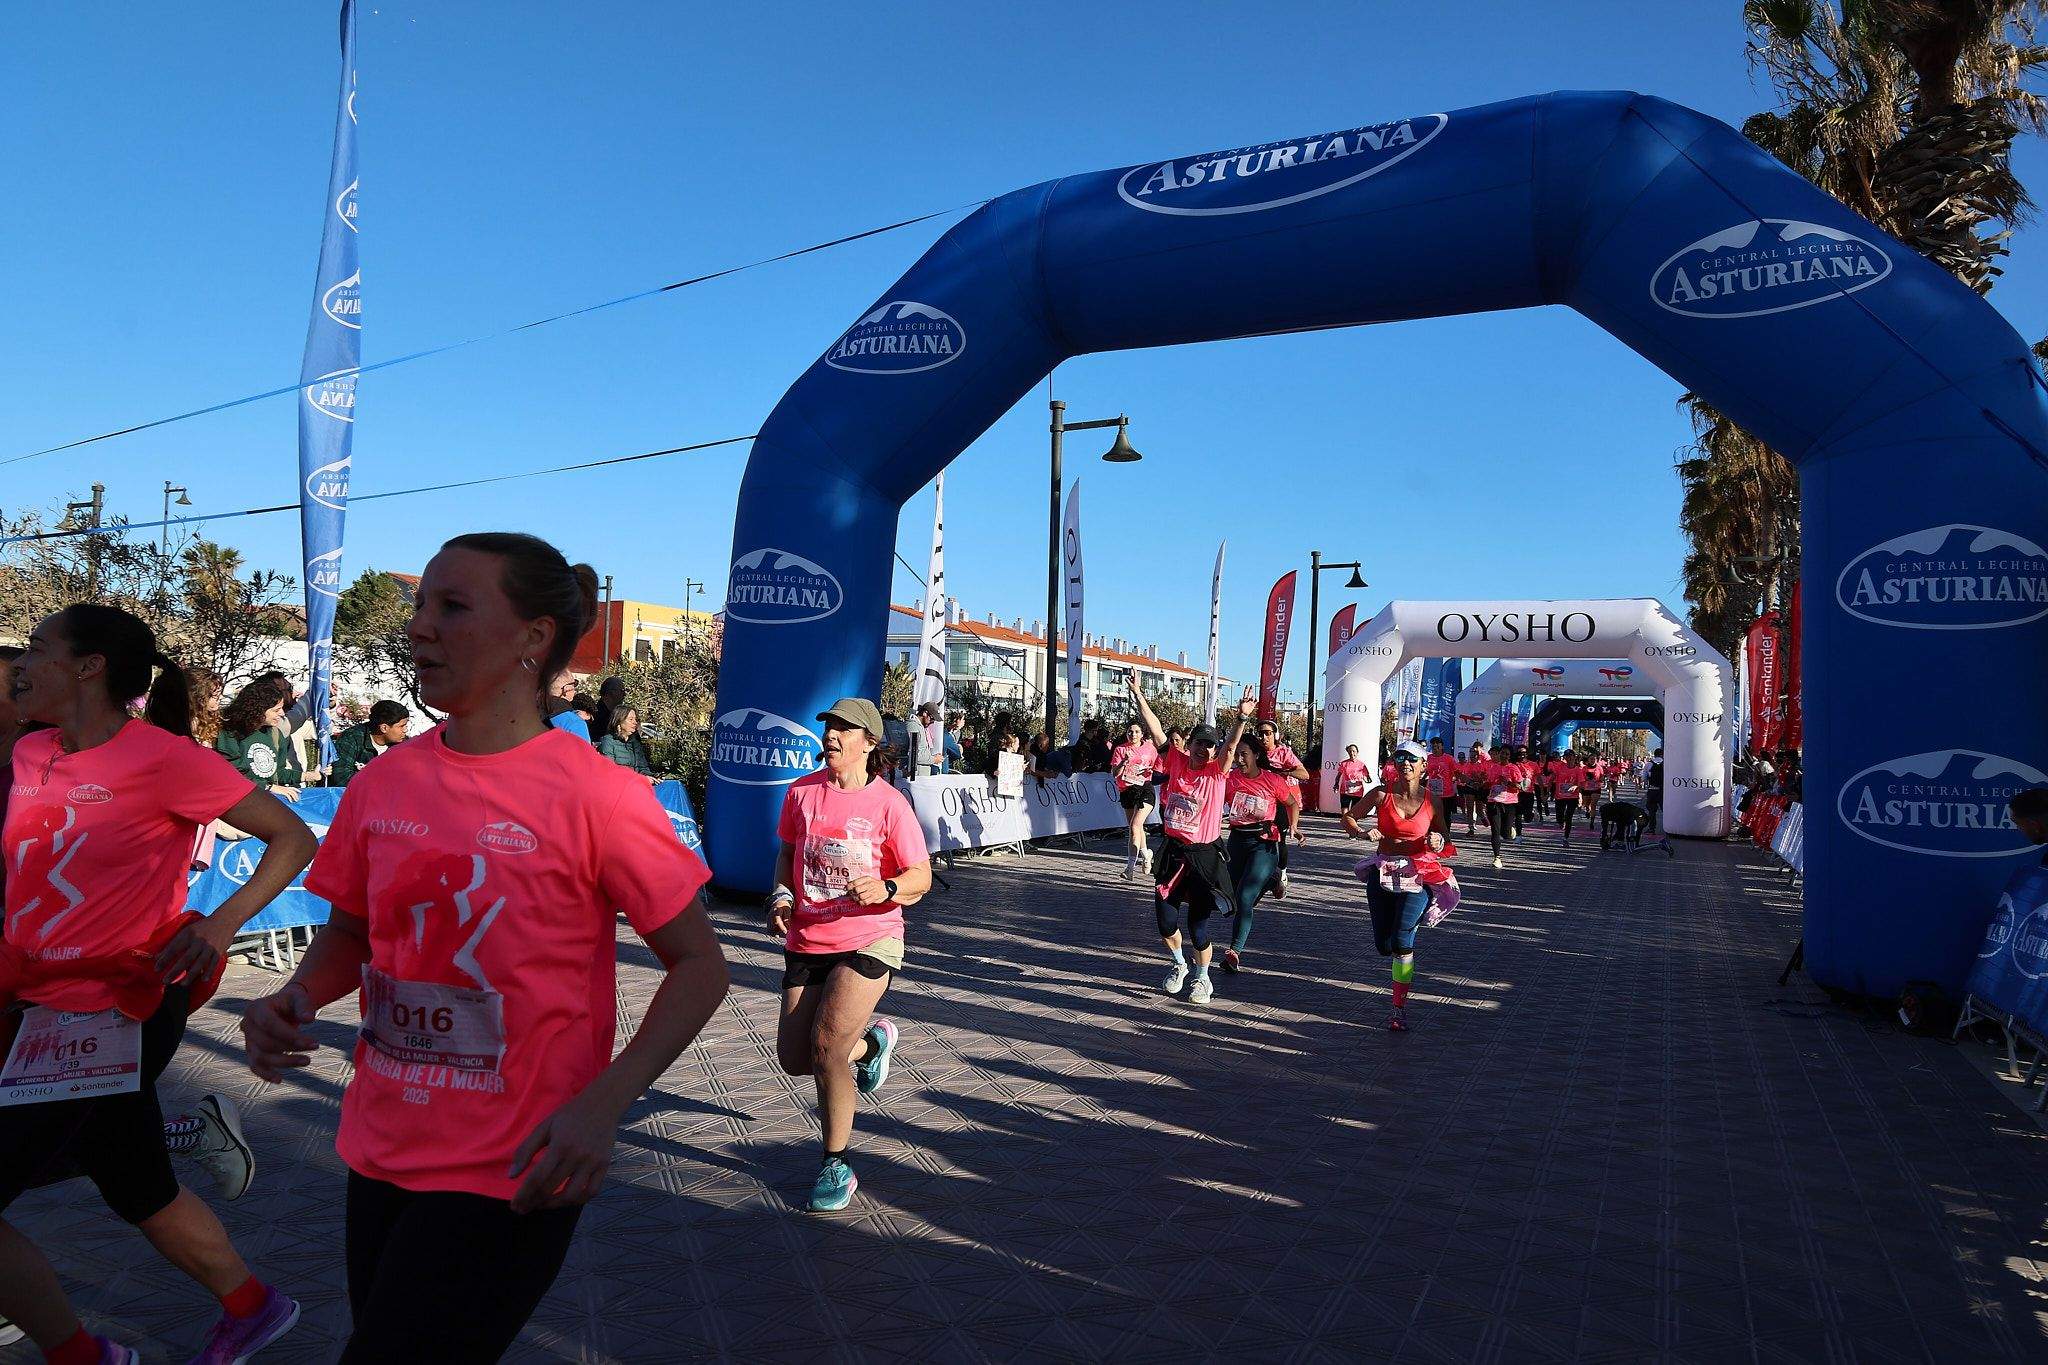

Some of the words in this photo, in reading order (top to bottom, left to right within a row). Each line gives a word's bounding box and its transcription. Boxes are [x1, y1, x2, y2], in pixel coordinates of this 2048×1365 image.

[1136, 120, 1419, 197] ASTURIANA
[1701, 249, 1779, 270] CENTRAL
[1787, 243, 1864, 256] LECHERA
[1668, 255, 1878, 304] ASTURIANA
[854, 324, 895, 337] CENTRAL
[898, 323, 949, 331] LECHERA
[830, 334, 953, 360] ASTURIANA
[1886, 561, 1969, 573] CENTRAL
[1978, 560, 2046, 572] LECHERA
[737, 573, 773, 583] CENTRAL
[777, 575, 828, 587] LECHERA
[1850, 567, 2048, 606] ASTURIANA
[728, 577, 831, 610] ASTURIANA
[1437, 613, 1596, 643] OYSHO
[1271, 597, 1286, 677] Santander
[1349, 646, 1392, 656] OYSHO
[1645, 646, 1697, 657] OYSHO
[1760, 634, 1773, 704] Santander
[1327, 702, 1367, 713] OYSHO
[1570, 705, 1642, 714] VOLVO
[1673, 712, 1722, 723] OYSHO
[720, 731, 755, 742] CENTRAL
[759, 735, 811, 748] LECHERA
[711, 739, 815, 770] ASTURIANA
[1672, 776, 1721, 788] OYSHO
[1887, 784, 1971, 797] CENTRAL
[1036, 780, 1090, 808] OYSHO
[1852, 785, 2019, 830] ASTURIA
[369, 819, 429, 836] OYSHO
[480, 833, 532, 850] ASTURIANA
[825, 865, 850, 877] 016
[392, 1002, 454, 1033] 016
[54, 1037, 98, 1062] 016
[403, 1035, 433, 1049] 1646
[413, 1052, 440, 1062] MUJER
[447, 1055, 484, 1066] VALENCIA
[91, 1066, 123, 1076] VALENCIA
[426, 1066, 446, 1088] LA
[451, 1069, 505, 1093] MUJER
[10, 1086, 53, 1098] OYSHO
[81, 1080, 125, 1091] Santander
[402, 1087, 430, 1105] 2025
